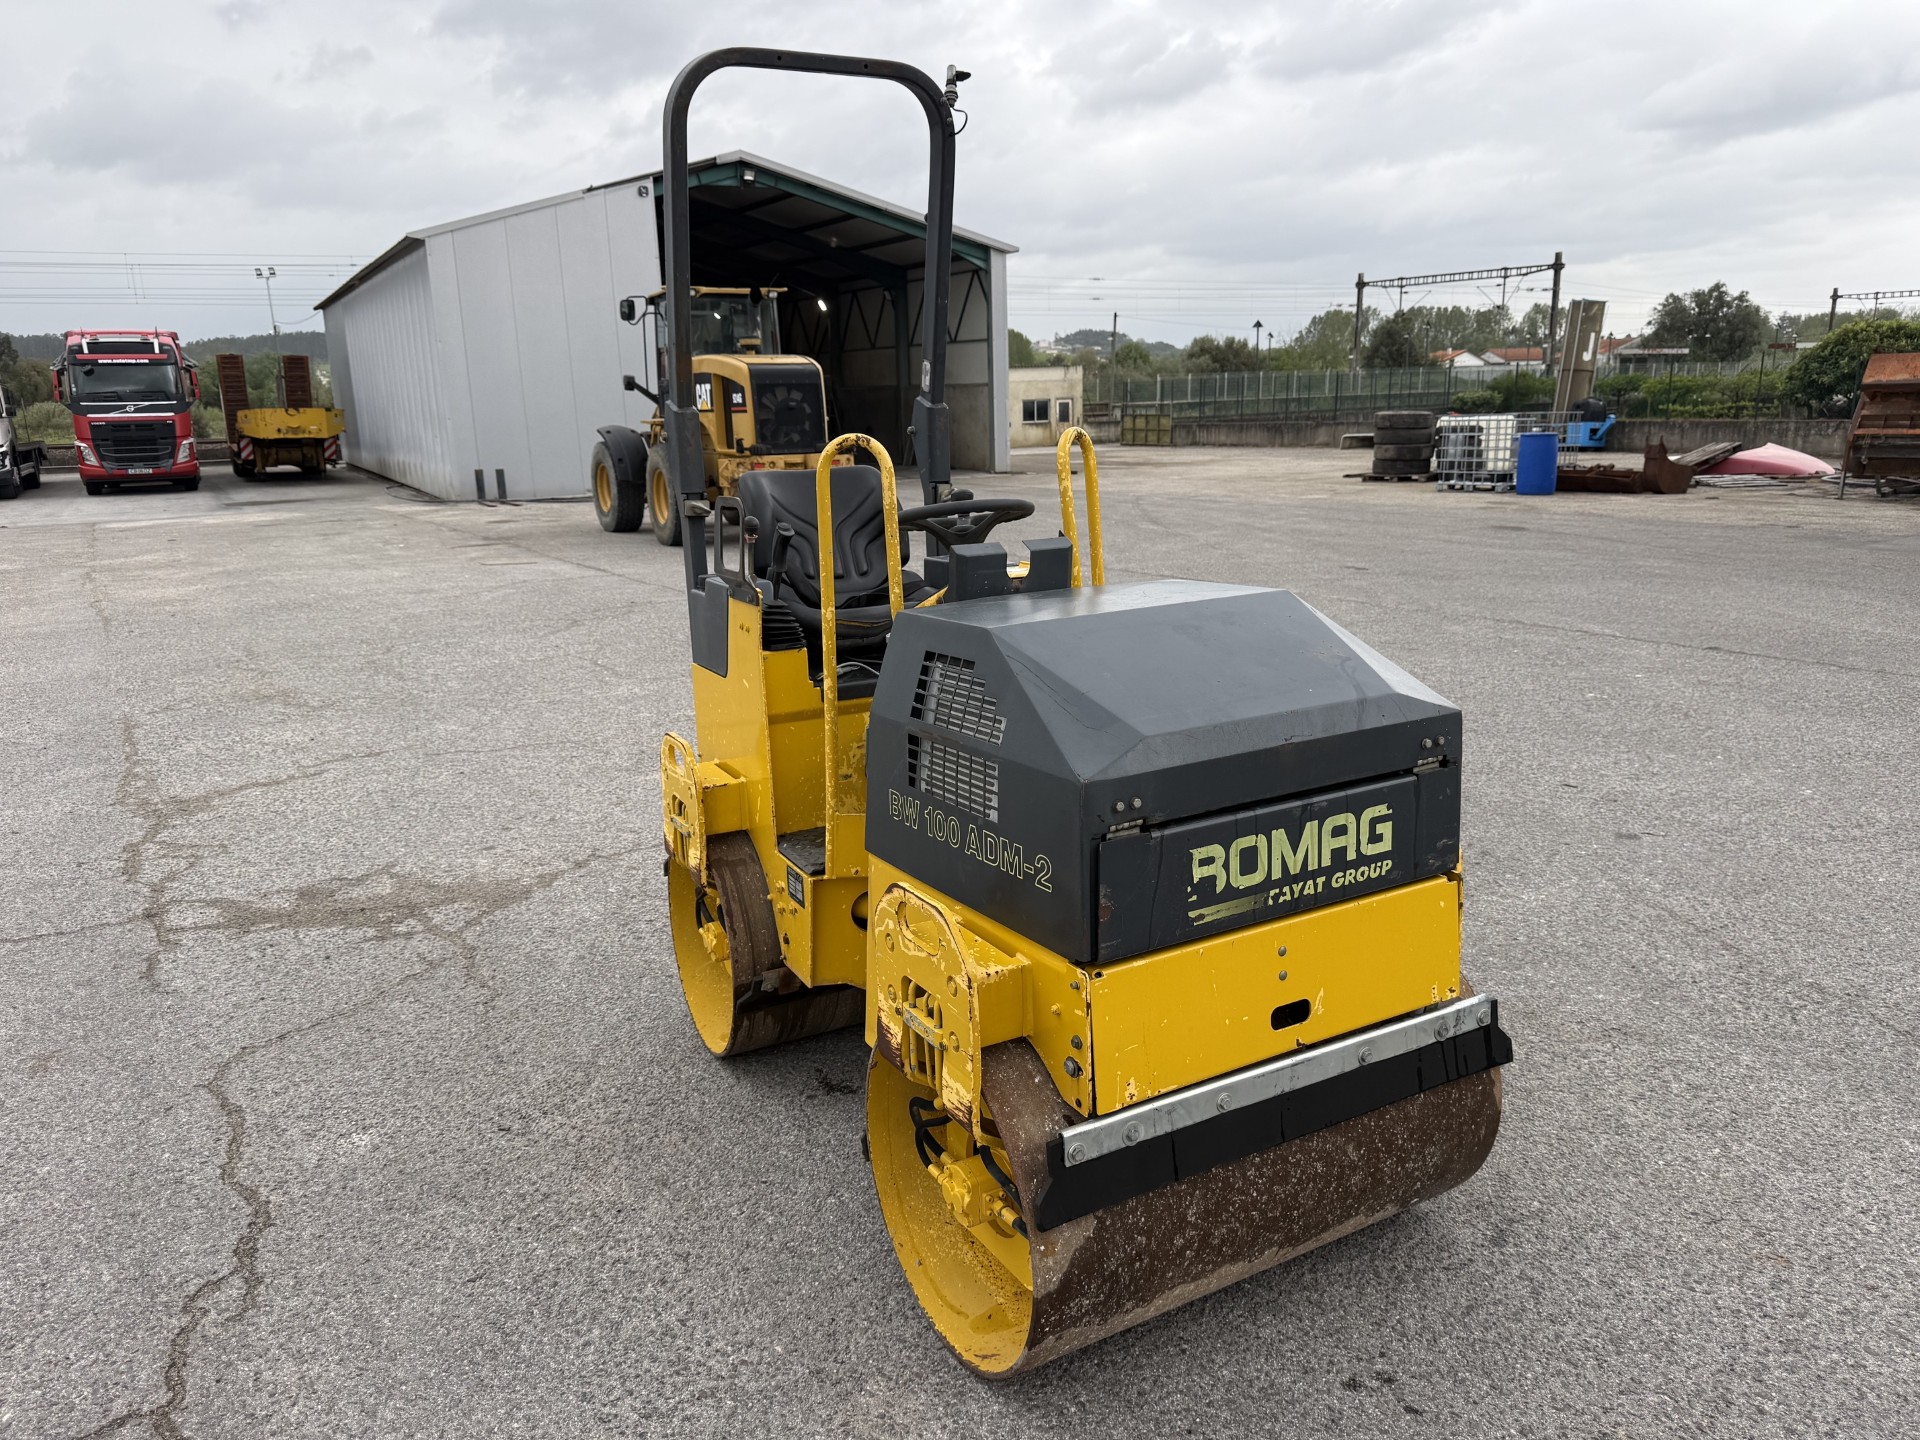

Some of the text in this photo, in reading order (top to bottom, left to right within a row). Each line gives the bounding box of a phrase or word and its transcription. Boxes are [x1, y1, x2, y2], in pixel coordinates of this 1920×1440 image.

[695, 383, 711, 410] CAT
[888, 788, 1053, 893] BW 100 ADM-2
[1330, 859, 1393, 889] GROUP
